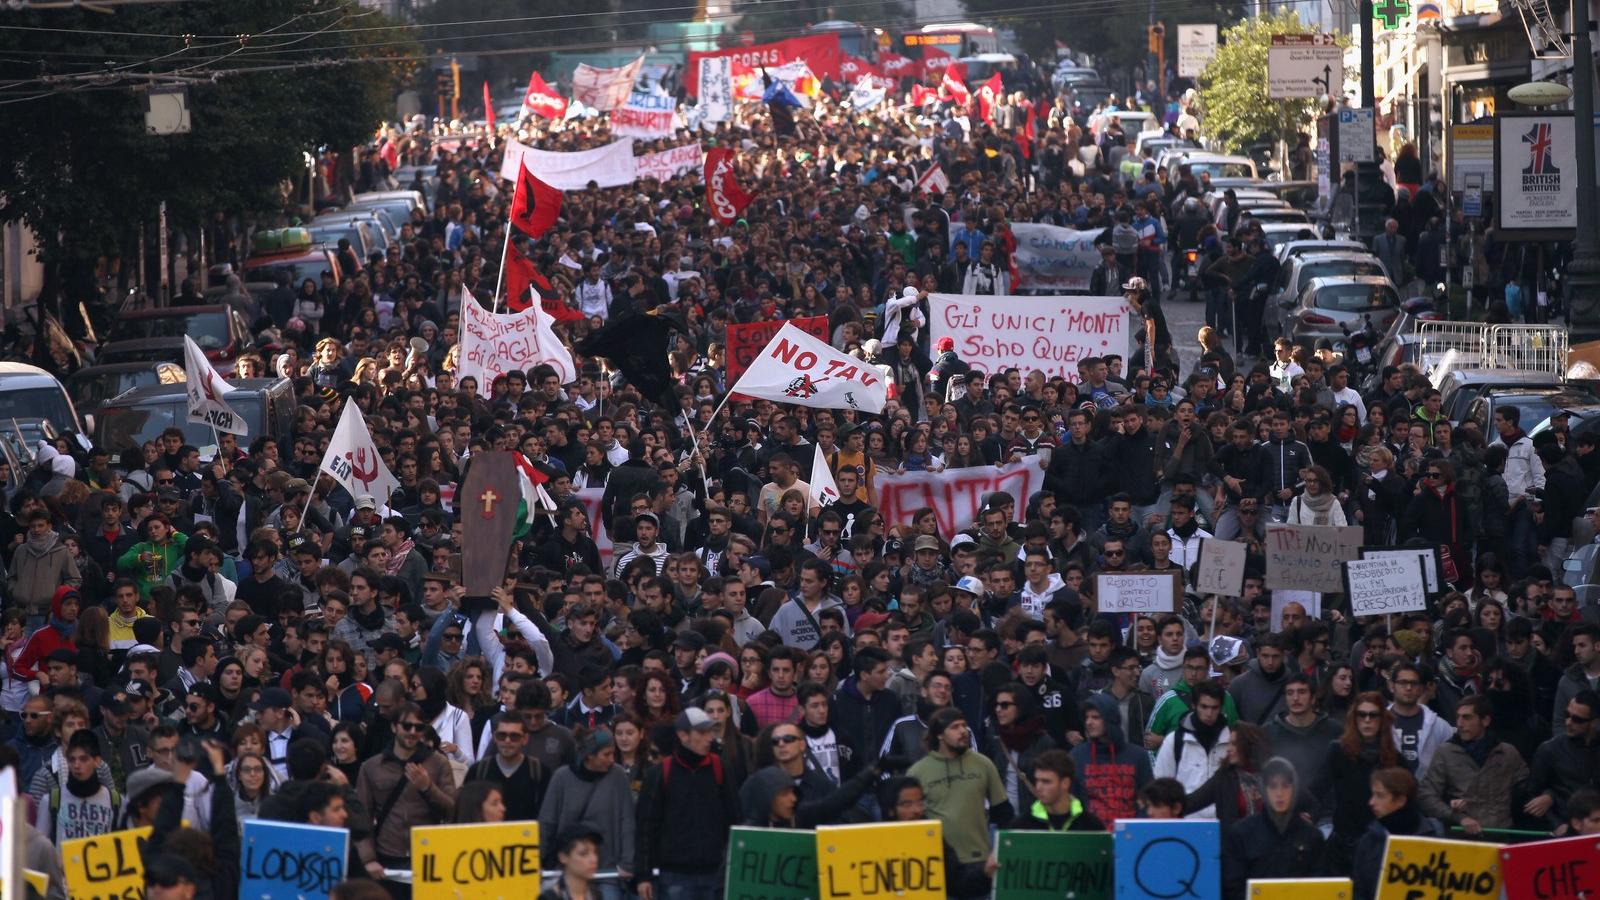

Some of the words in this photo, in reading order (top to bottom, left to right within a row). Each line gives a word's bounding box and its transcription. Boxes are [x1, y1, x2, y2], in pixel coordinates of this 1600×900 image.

[1522, 175, 1560, 184] BRITISH
[1522, 184, 1560, 192] INSTITUTES
[992, 313, 1054, 333] UNICI
[771, 338, 818, 371] NO
[824, 359, 878, 387] TAV
[204, 410, 233, 429] RICH
[330, 455, 352, 481] EAT
[1106, 577, 1158, 588] REDDITO
[1357, 594, 1410, 611] CRESCITA
[796, 635, 816, 643] JOCK
[1043, 693, 1062, 708] 36
[422, 854, 442, 883] IL
[452, 845, 539, 885] CONTE
[740, 852, 812, 889] ALICE
[1134, 837, 1200, 899] Q
[828, 857, 942, 897] L'ENEIDE
[1387, 863, 1495, 895] DOMINIO
[1533, 860, 1594, 899] CHE
